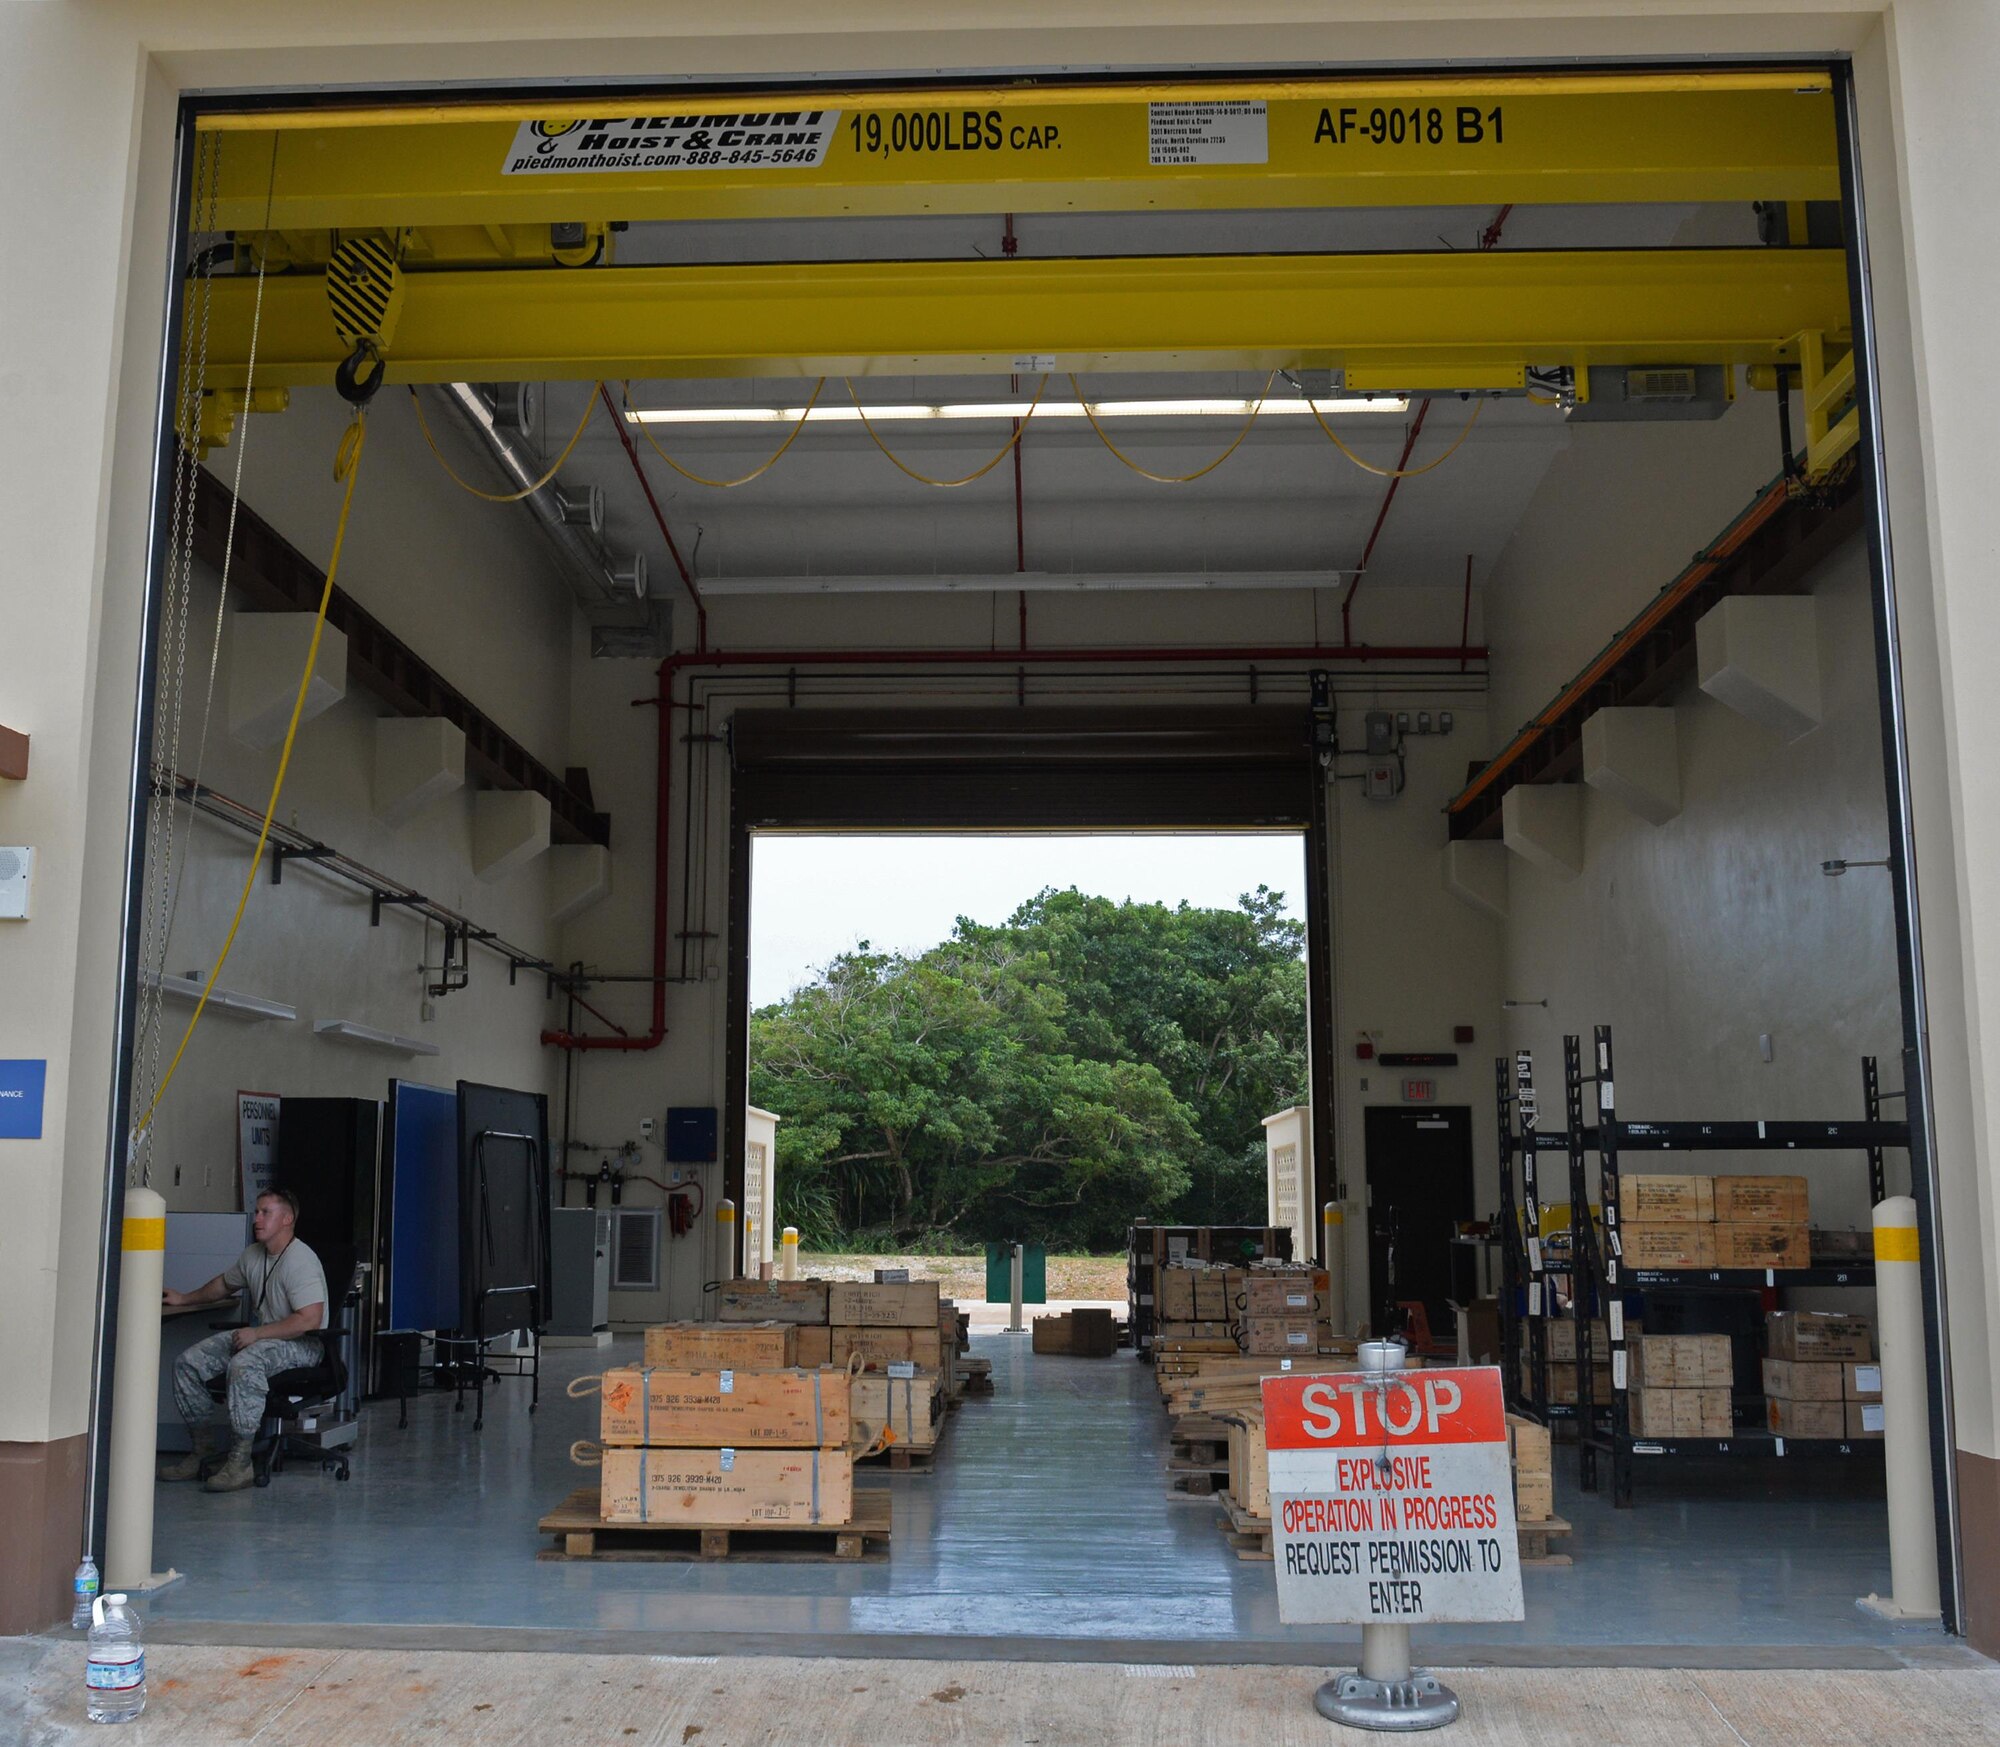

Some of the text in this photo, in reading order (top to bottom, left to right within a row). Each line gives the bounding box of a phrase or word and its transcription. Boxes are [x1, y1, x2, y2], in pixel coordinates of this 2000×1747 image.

[1150, 109, 1174, 117] Contract
[1174, 109, 1195, 117] Number
[1150, 118, 1176, 126] Piedmont
[1176, 118, 1191, 126] Hoist
[1196, 117, 1212, 125] Crane
[1314, 106, 1503, 145] AF-9018 B1
[1010, 125, 1062, 150] CAP.
[1185, 136, 1209, 144] Carolina
[1408, 1080, 1432, 1099] EXIT
[243, 1101, 276, 1120] PERSONNEL
[1827, 1127, 1838, 1136] 2C
[665, 1394, 680, 1404] 926
[1302, 1379, 1462, 1439] STOP
[667, 1475, 682, 1484] 926
[1338, 1456, 1432, 1492] EXPLOSIVE
[752, 1508, 762, 1517] LOT
[1282, 1494, 1497, 1533] OPERATION IN PROGRESS
[1285, 1538, 1501, 1576] REQUEST PERMISSION TO
[1368, 1580, 1423, 1614] ENTER
